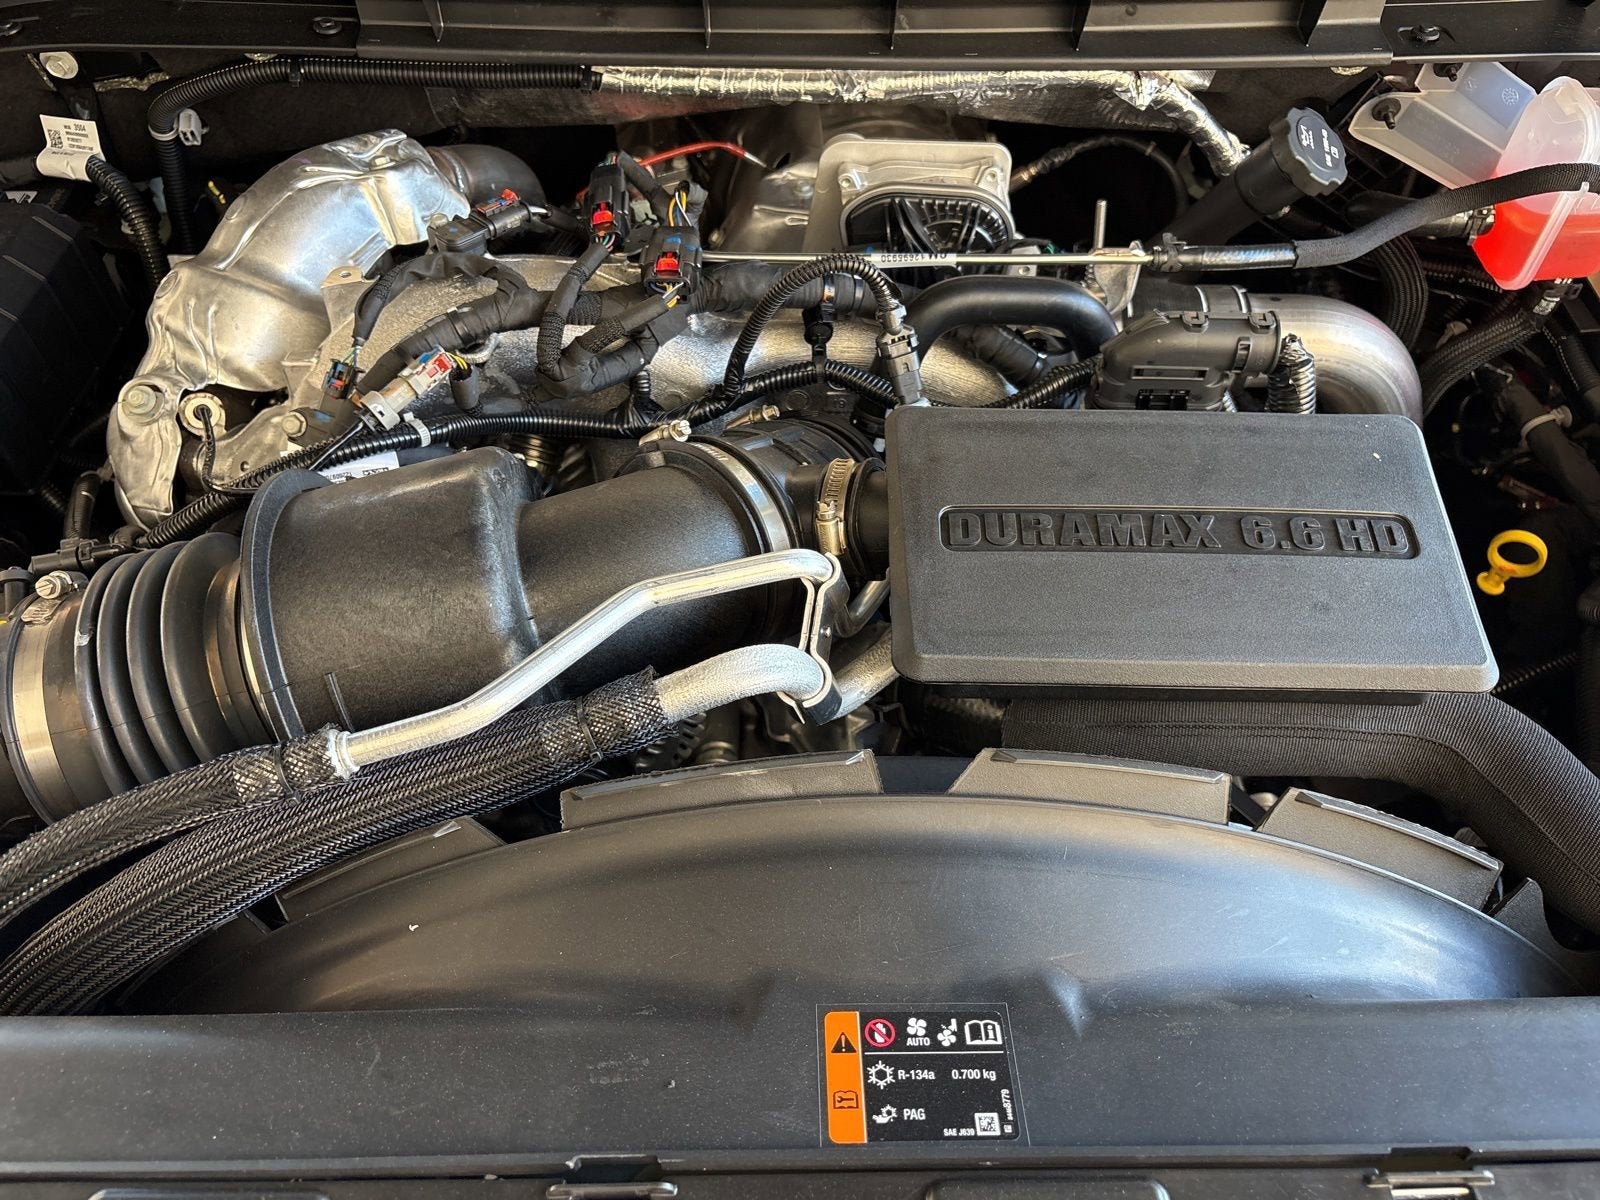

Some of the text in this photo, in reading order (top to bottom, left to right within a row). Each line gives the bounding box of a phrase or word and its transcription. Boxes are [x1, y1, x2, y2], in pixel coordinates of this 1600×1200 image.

[948, 512, 1410, 554] DURAMAX 6.6 HD
[906, 1037, 931, 1046] AUTO
[897, 1068, 997, 1081] R-134a 0.700 kg
[903, 1108, 926, 1120] PAG
[943, 1128, 957, 1136] SAE
